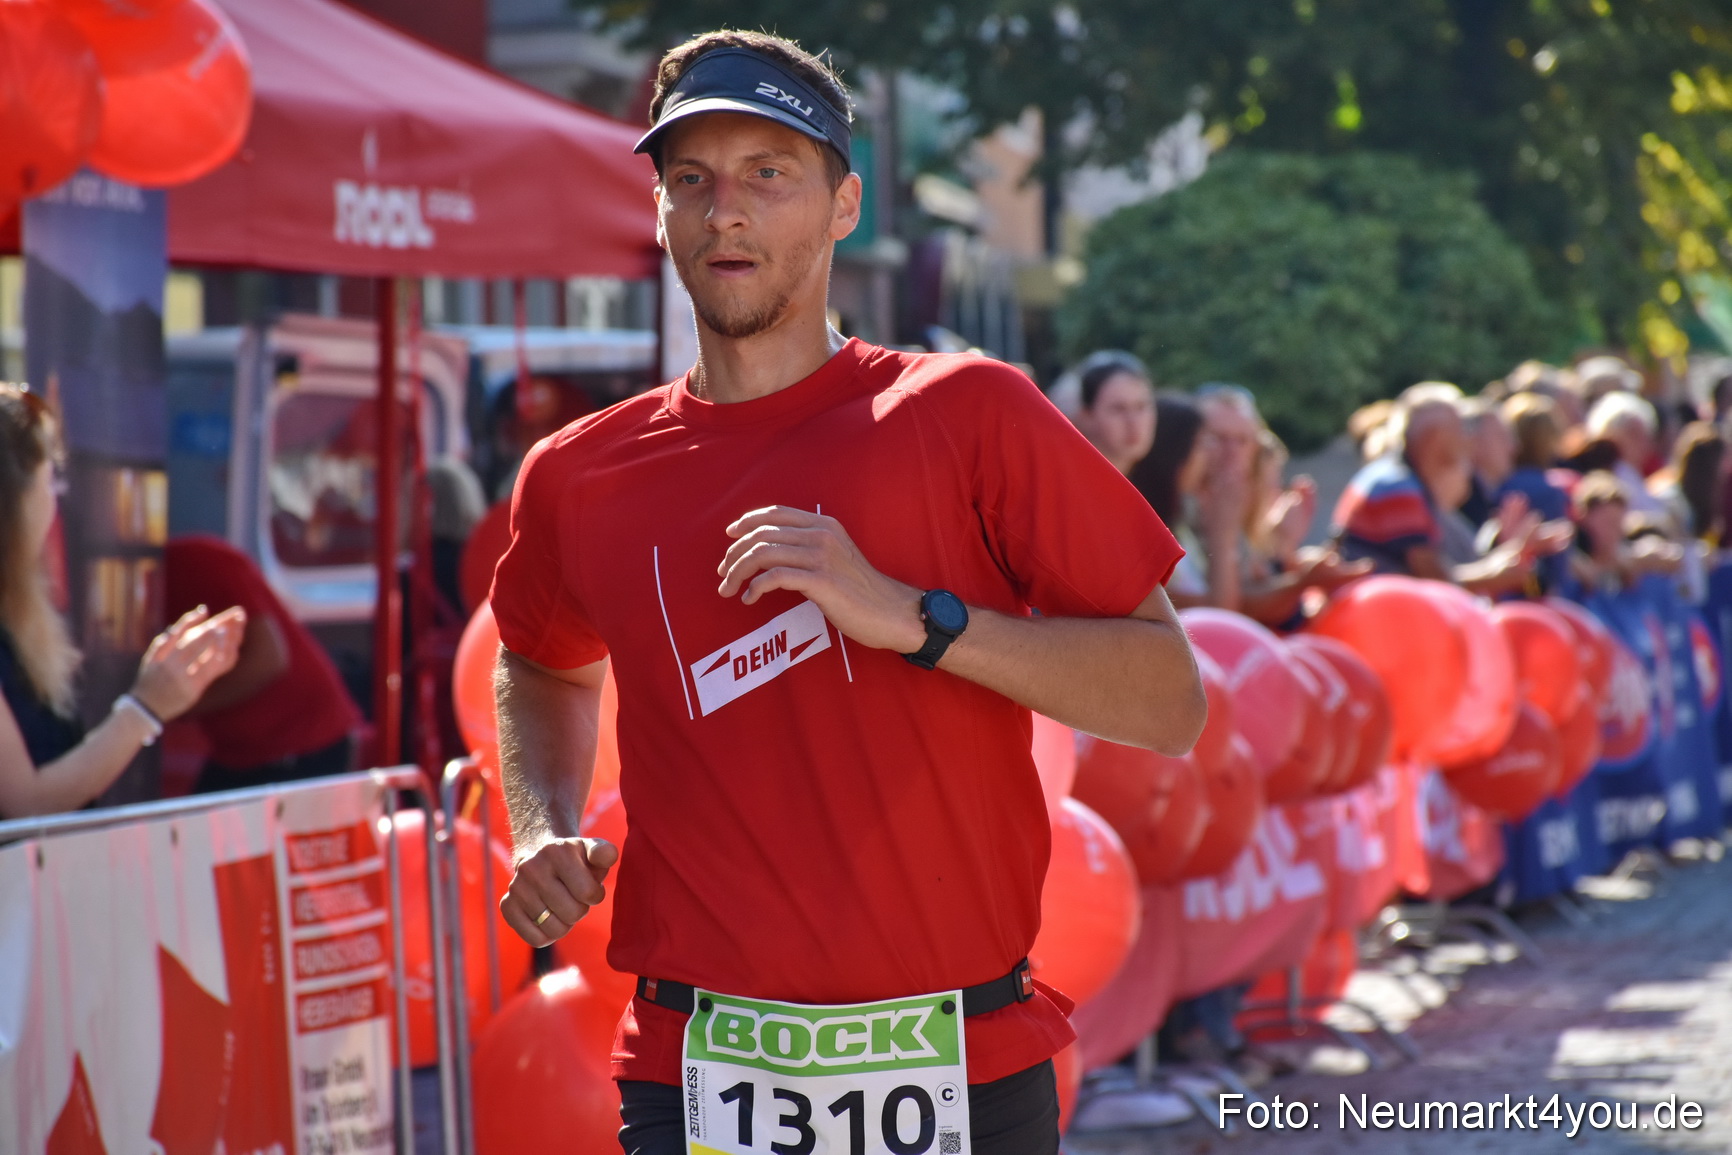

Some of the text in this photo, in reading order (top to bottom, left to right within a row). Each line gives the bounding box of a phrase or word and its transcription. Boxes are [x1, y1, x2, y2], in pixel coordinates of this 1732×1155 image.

[755, 82, 813, 116] 2XU
[733, 629, 787, 682] DEHN
[706, 1003, 940, 1068] BOCK
[718, 1080, 936, 1155] 1310
